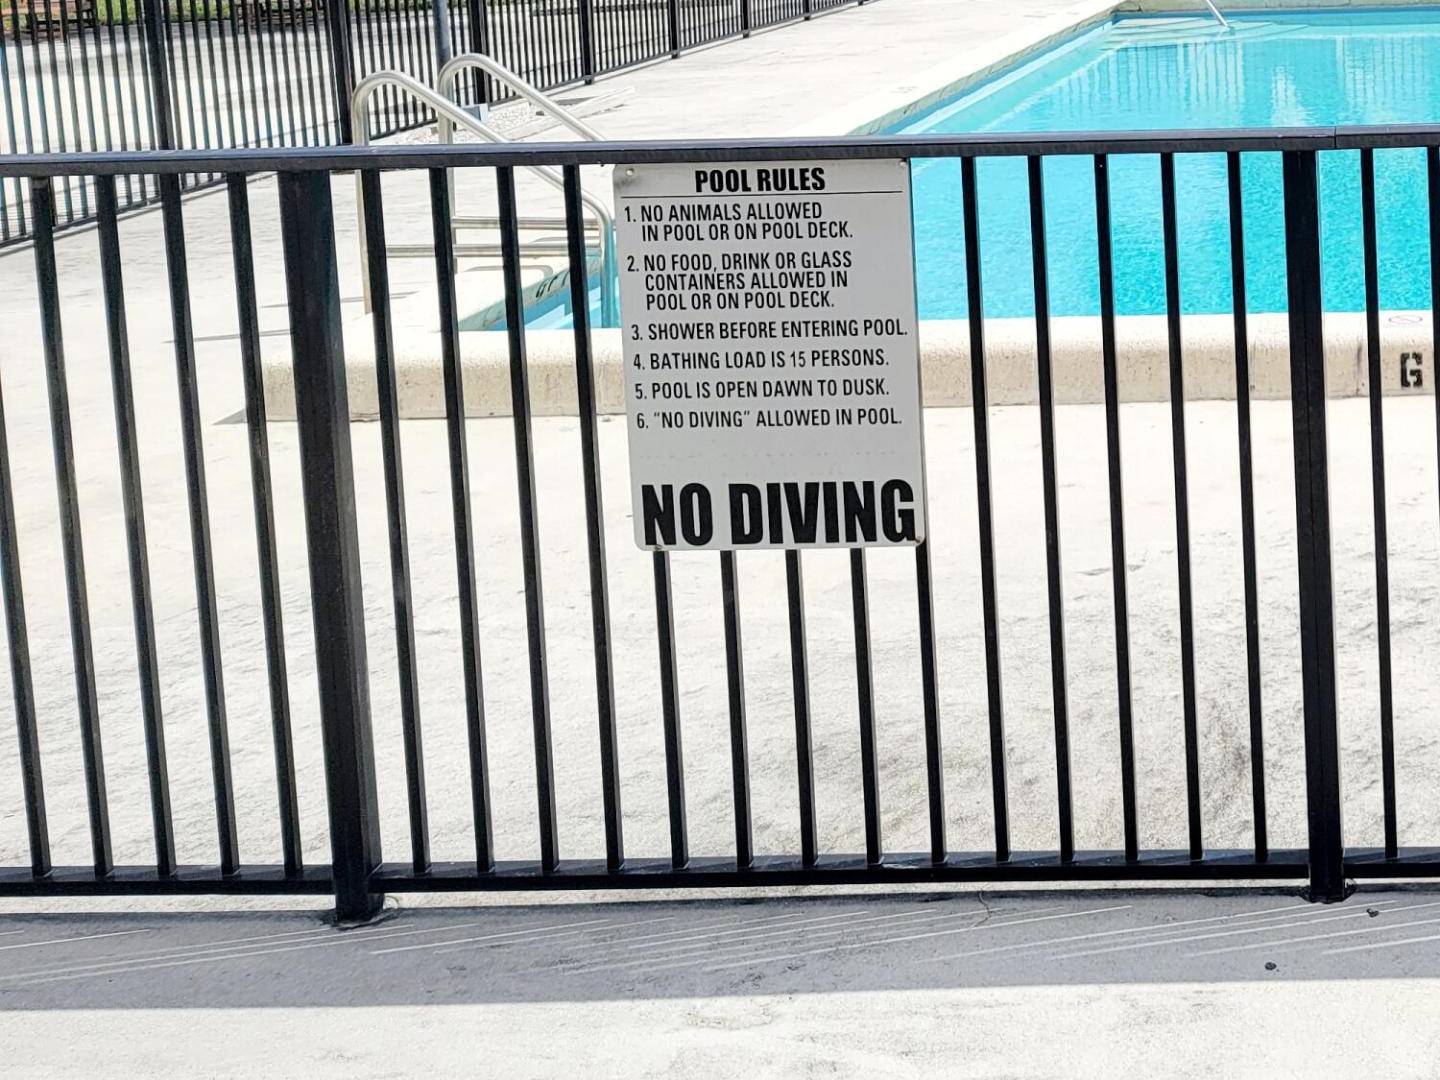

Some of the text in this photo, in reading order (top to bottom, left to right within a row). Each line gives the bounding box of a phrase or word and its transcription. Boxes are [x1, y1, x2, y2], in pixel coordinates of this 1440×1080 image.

[695, 167, 825, 192] POOL RULES
[625, 202, 822, 222] 1. NO ANIMALS ALLOWED
[642, 221, 852, 241] IN POOL OR ON POOL DECK.
[627, 250, 851, 272] 2. NO FOOD, DRINK OR GLASS
[646, 271, 847, 291] CONTAINERS ALLOWED IN
[647, 291, 834, 310] POOL OR ON POOL DECK.
[632, 319, 907, 340] 3. SHOWER BEFORE ENTERING POOL.
[634, 349, 888, 369] 4. BATHING LOAD IS 15 PERSONS.
[635, 378, 889, 399] 5. POOL IS OPEN DAWN TO DUSK.
[637, 408, 901, 428] 6. "NO DIVING" ALLOWED IN POOL.
[642, 479, 916, 547] NO DIVING
